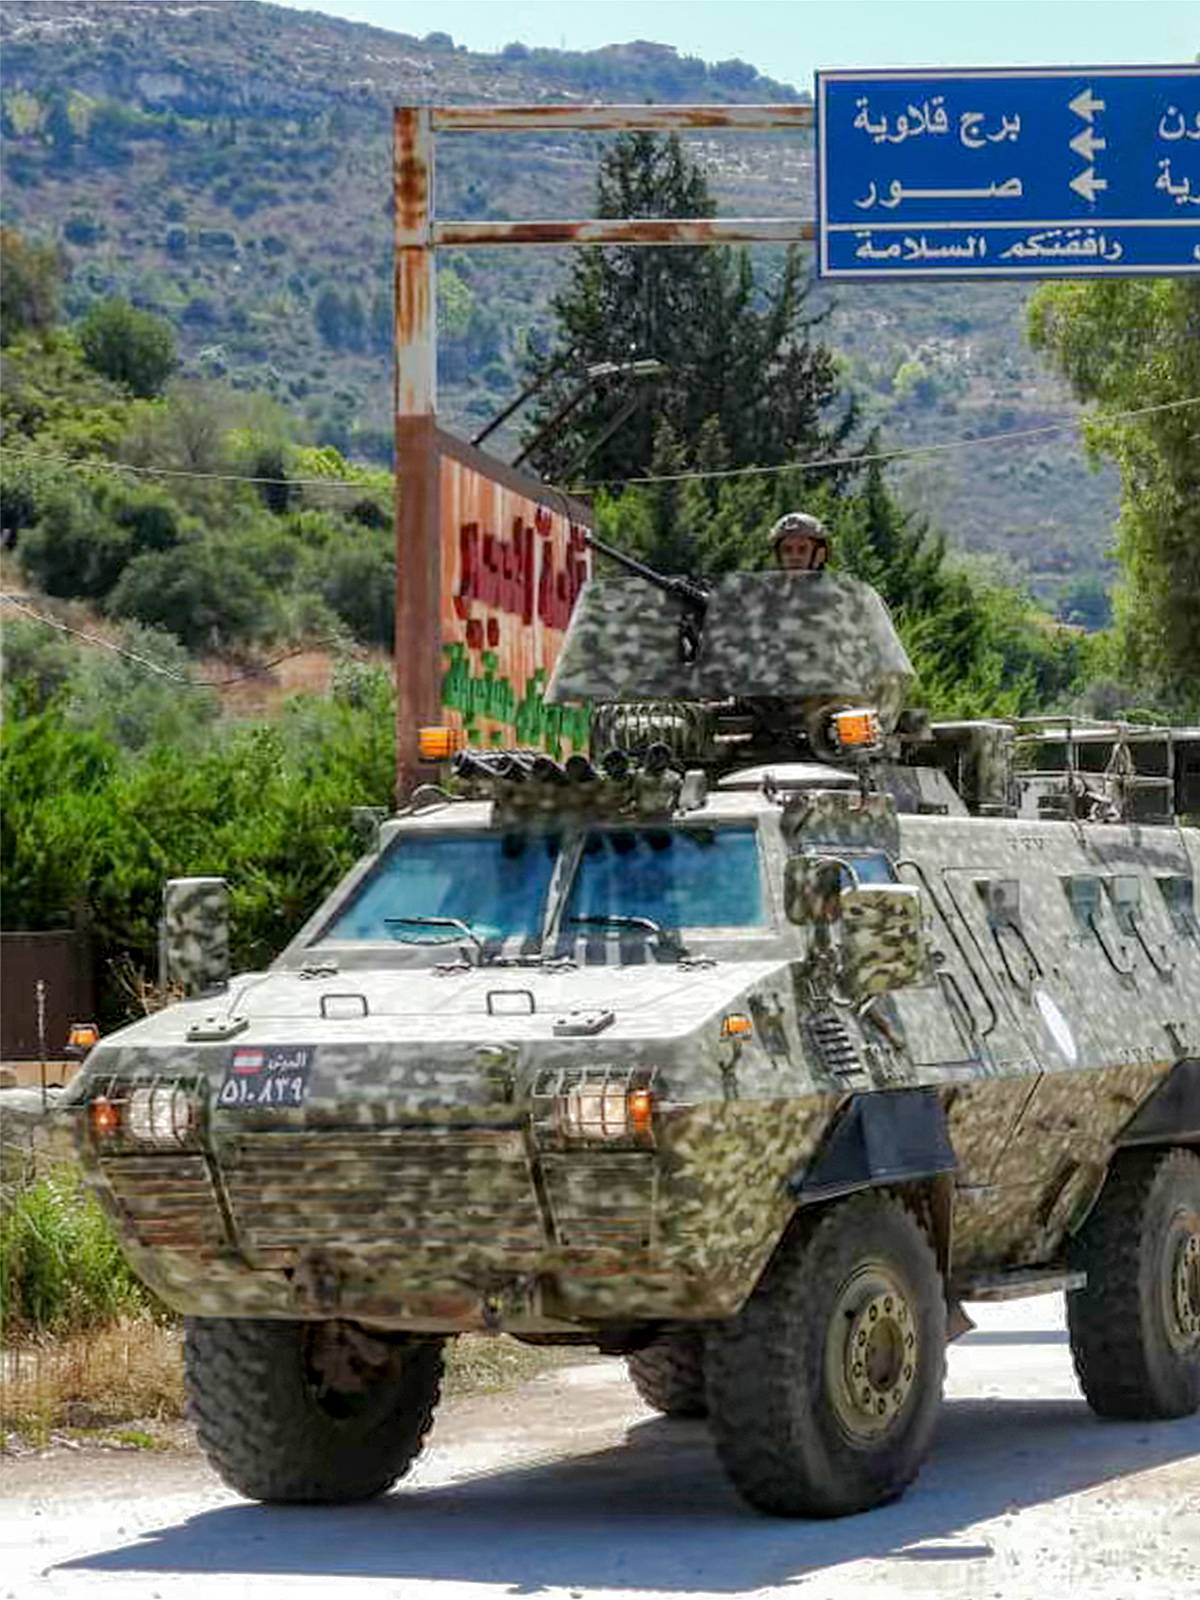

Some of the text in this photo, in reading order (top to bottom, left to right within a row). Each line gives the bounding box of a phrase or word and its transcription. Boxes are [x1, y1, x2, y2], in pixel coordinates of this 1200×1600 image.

[854, 99, 1021, 147] برج قلاوية
[855, 178, 1023, 208] صور
[855, 230, 1123, 261] رافقتكم السلامة
